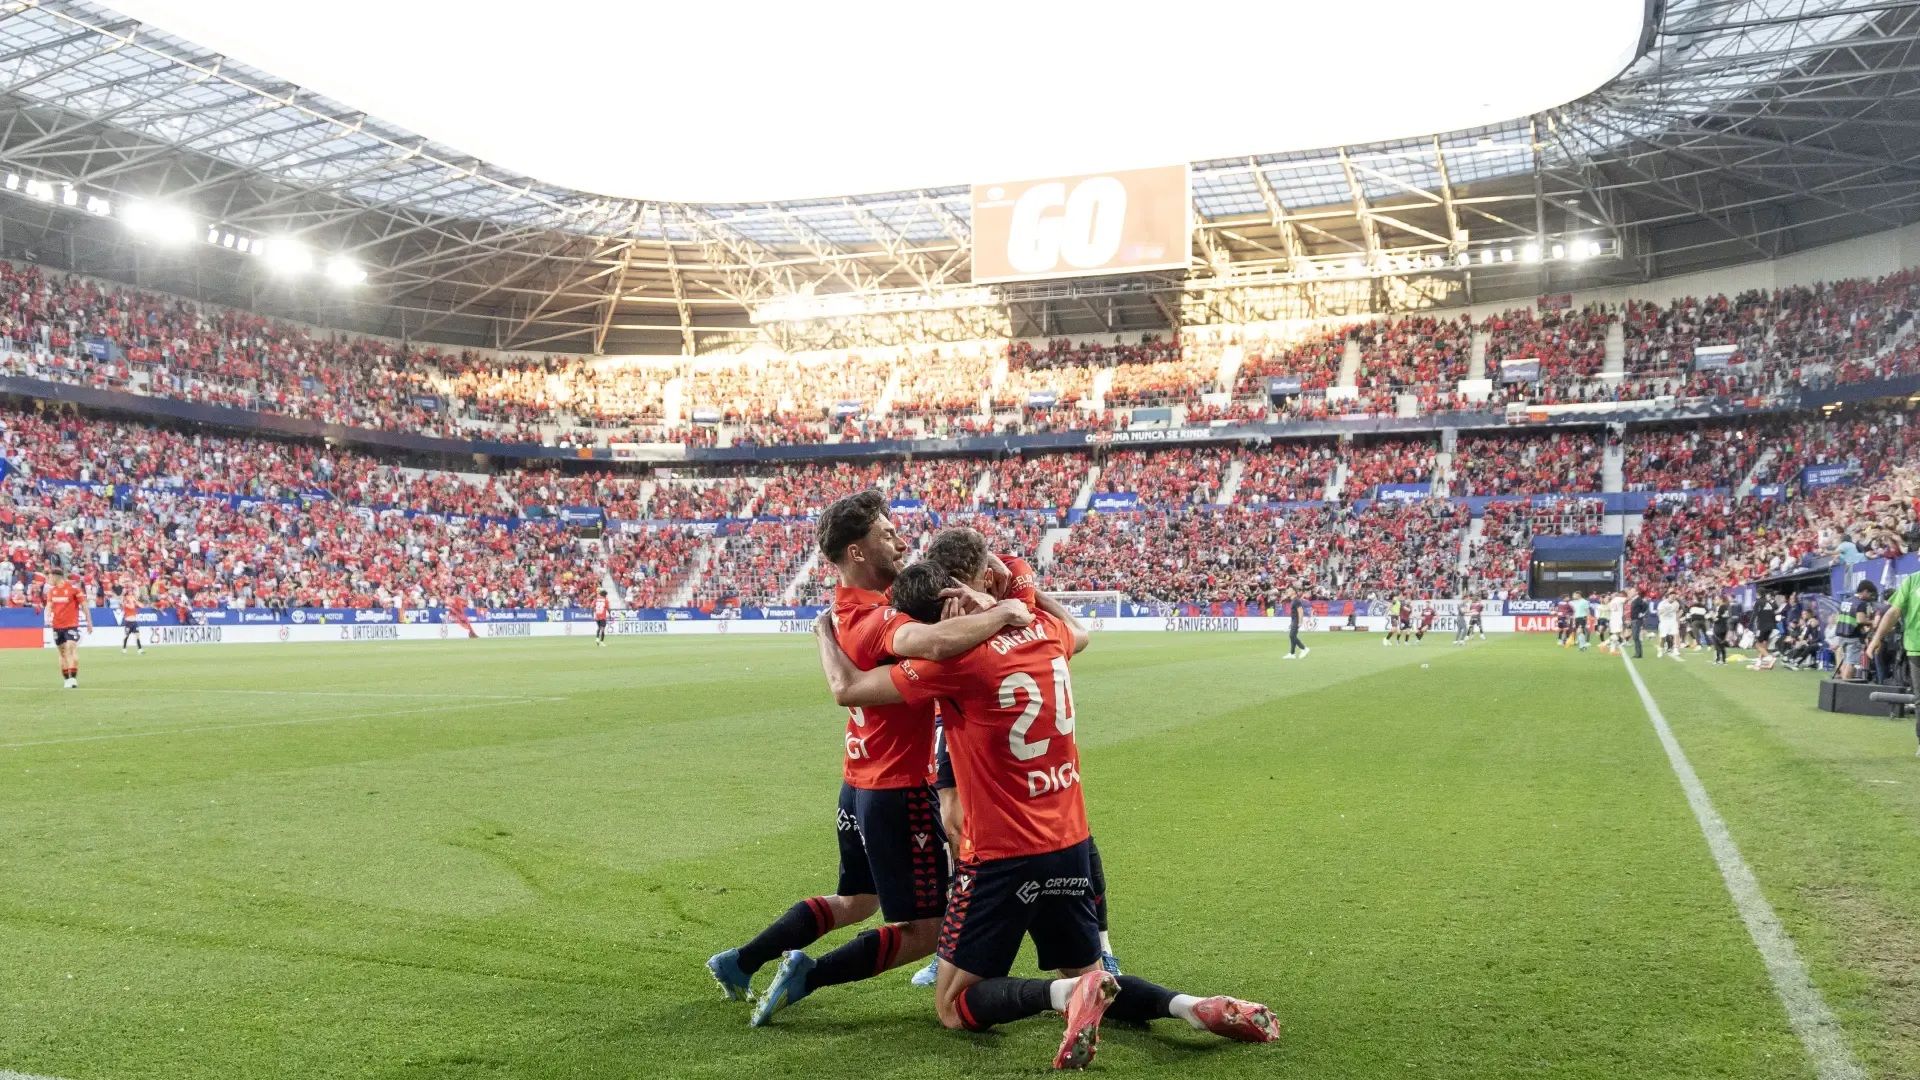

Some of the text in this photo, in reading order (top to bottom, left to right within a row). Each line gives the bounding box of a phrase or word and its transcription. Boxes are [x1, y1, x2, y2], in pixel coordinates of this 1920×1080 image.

[1131, 430, 1165, 441] NUNCA
[1166, 430, 1179, 439] SE
[1180, 428, 1210, 439] RINDE
[769, 609, 796, 617] macron
[495, 622, 530, 636] ANIVERSARIO
[619, 620, 667, 633] URTEURRENA
[780, 620, 788, 632] 25
[1165, 617, 1239, 632] 25 ANIVERSARIO
[150, 626, 222, 644] 25 ANIVERSARIO
[990, 623, 1048, 655] CATENA
[998, 655, 1076, 761] 24
[1045, 877, 1089, 888] CRYPTO
